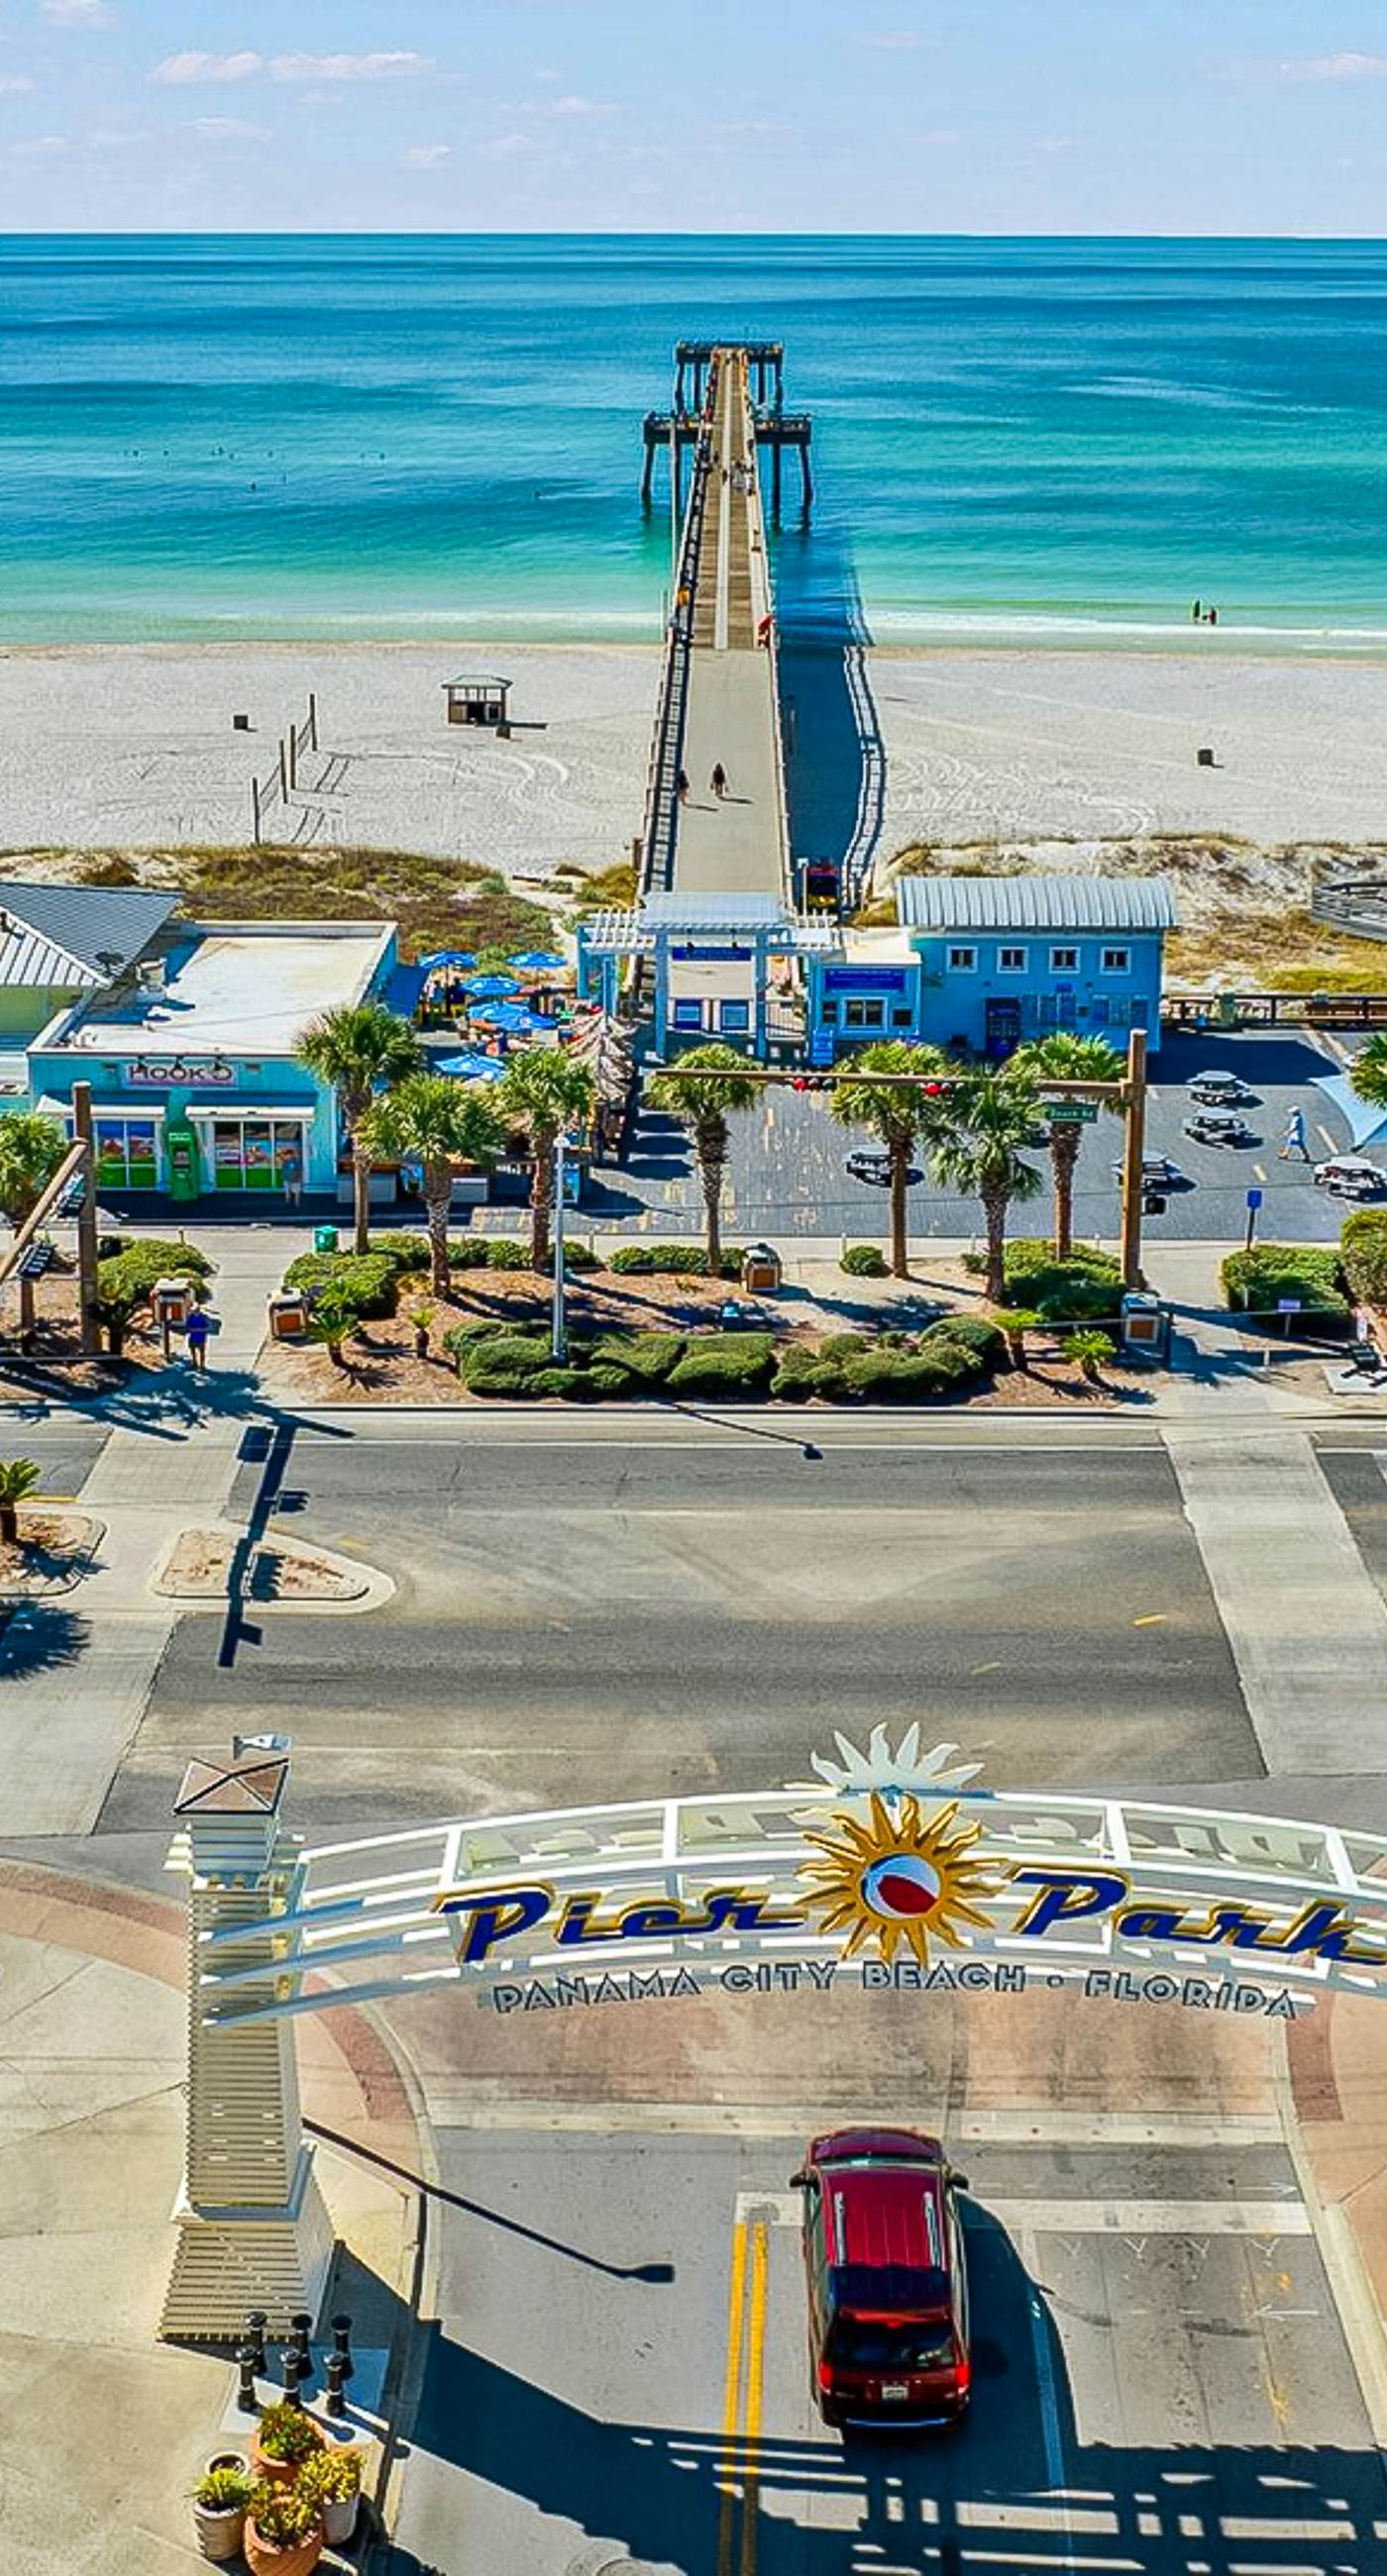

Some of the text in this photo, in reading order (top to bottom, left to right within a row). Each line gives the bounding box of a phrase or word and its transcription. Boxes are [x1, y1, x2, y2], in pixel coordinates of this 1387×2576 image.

[430, 1862, 1387, 1967] Pier Park
[494, 1960, 1301, 2020] PANAMA CITY BEACH FLORIDA
